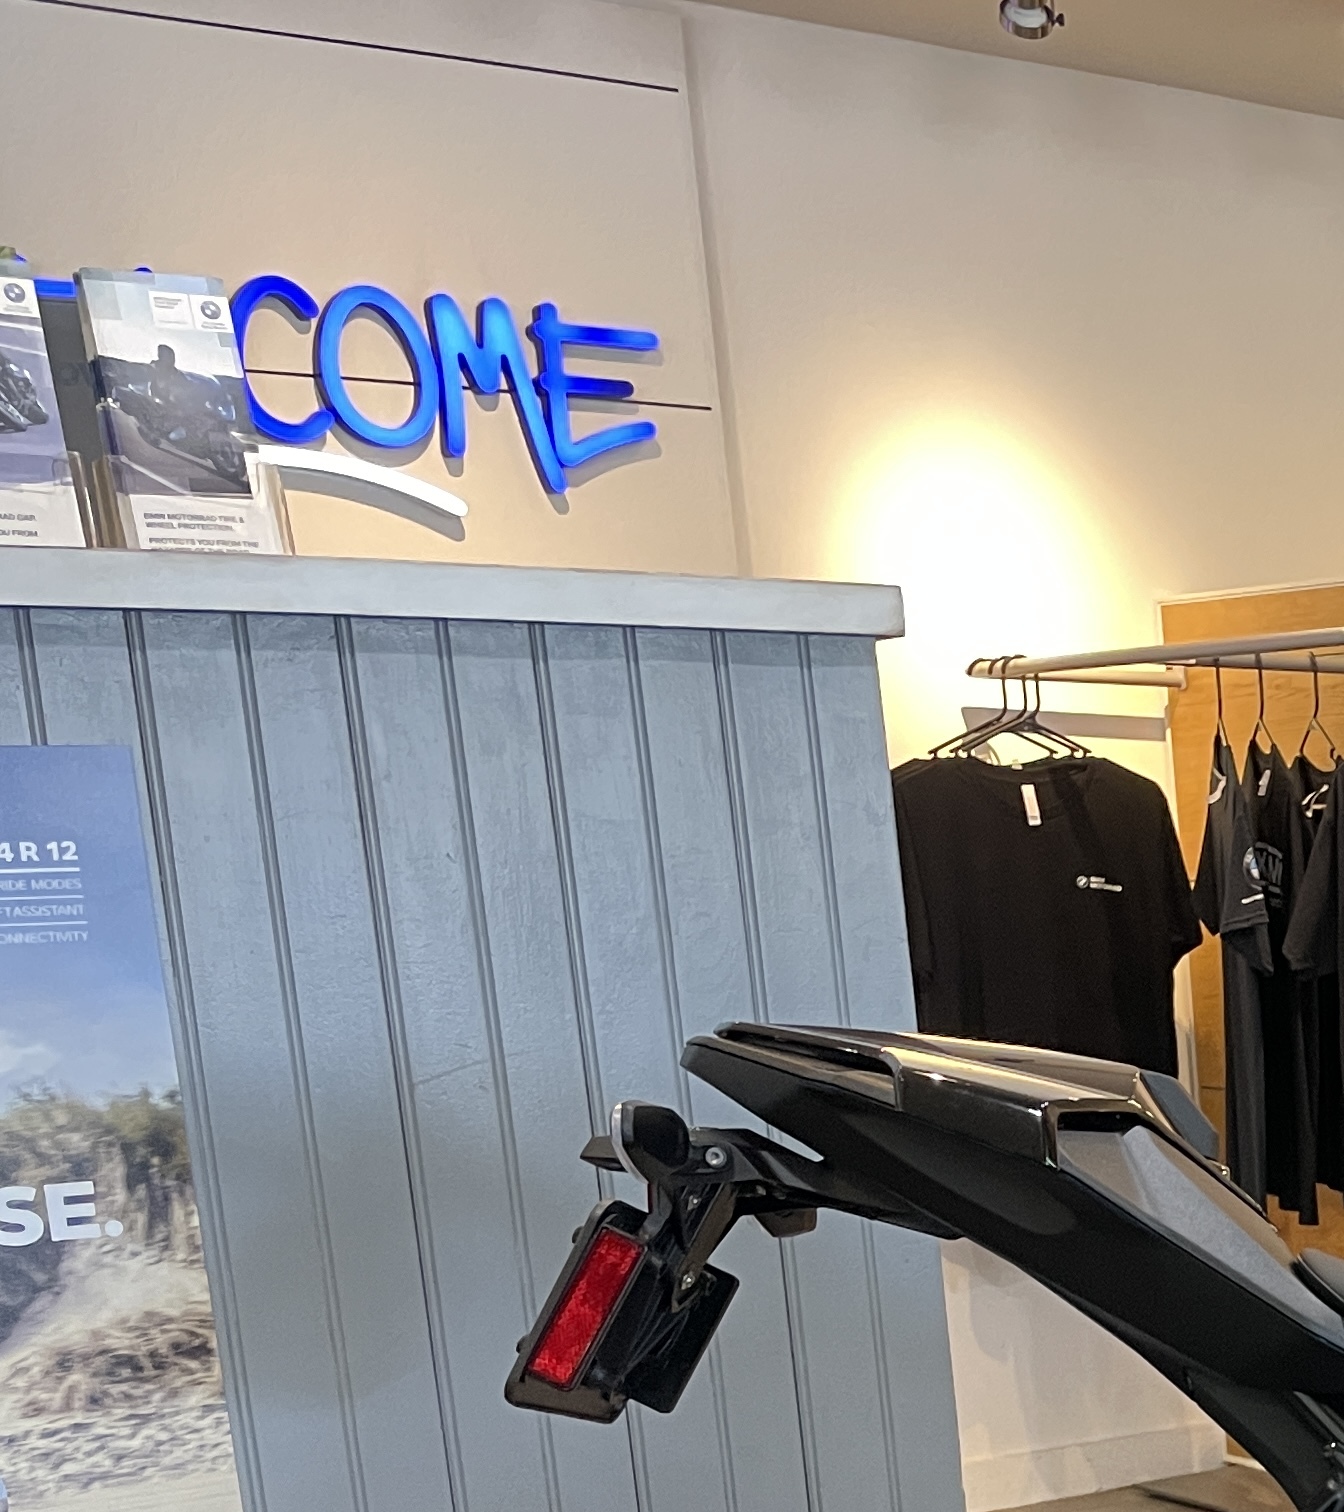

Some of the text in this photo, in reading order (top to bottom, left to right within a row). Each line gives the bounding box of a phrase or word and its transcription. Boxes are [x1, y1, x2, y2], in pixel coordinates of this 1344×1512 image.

[222, 270, 658, 494] COME
[19, 842, 40, 862] R
[46, 841, 79, 861] 12
[31, 878, 82, 890] MODES
